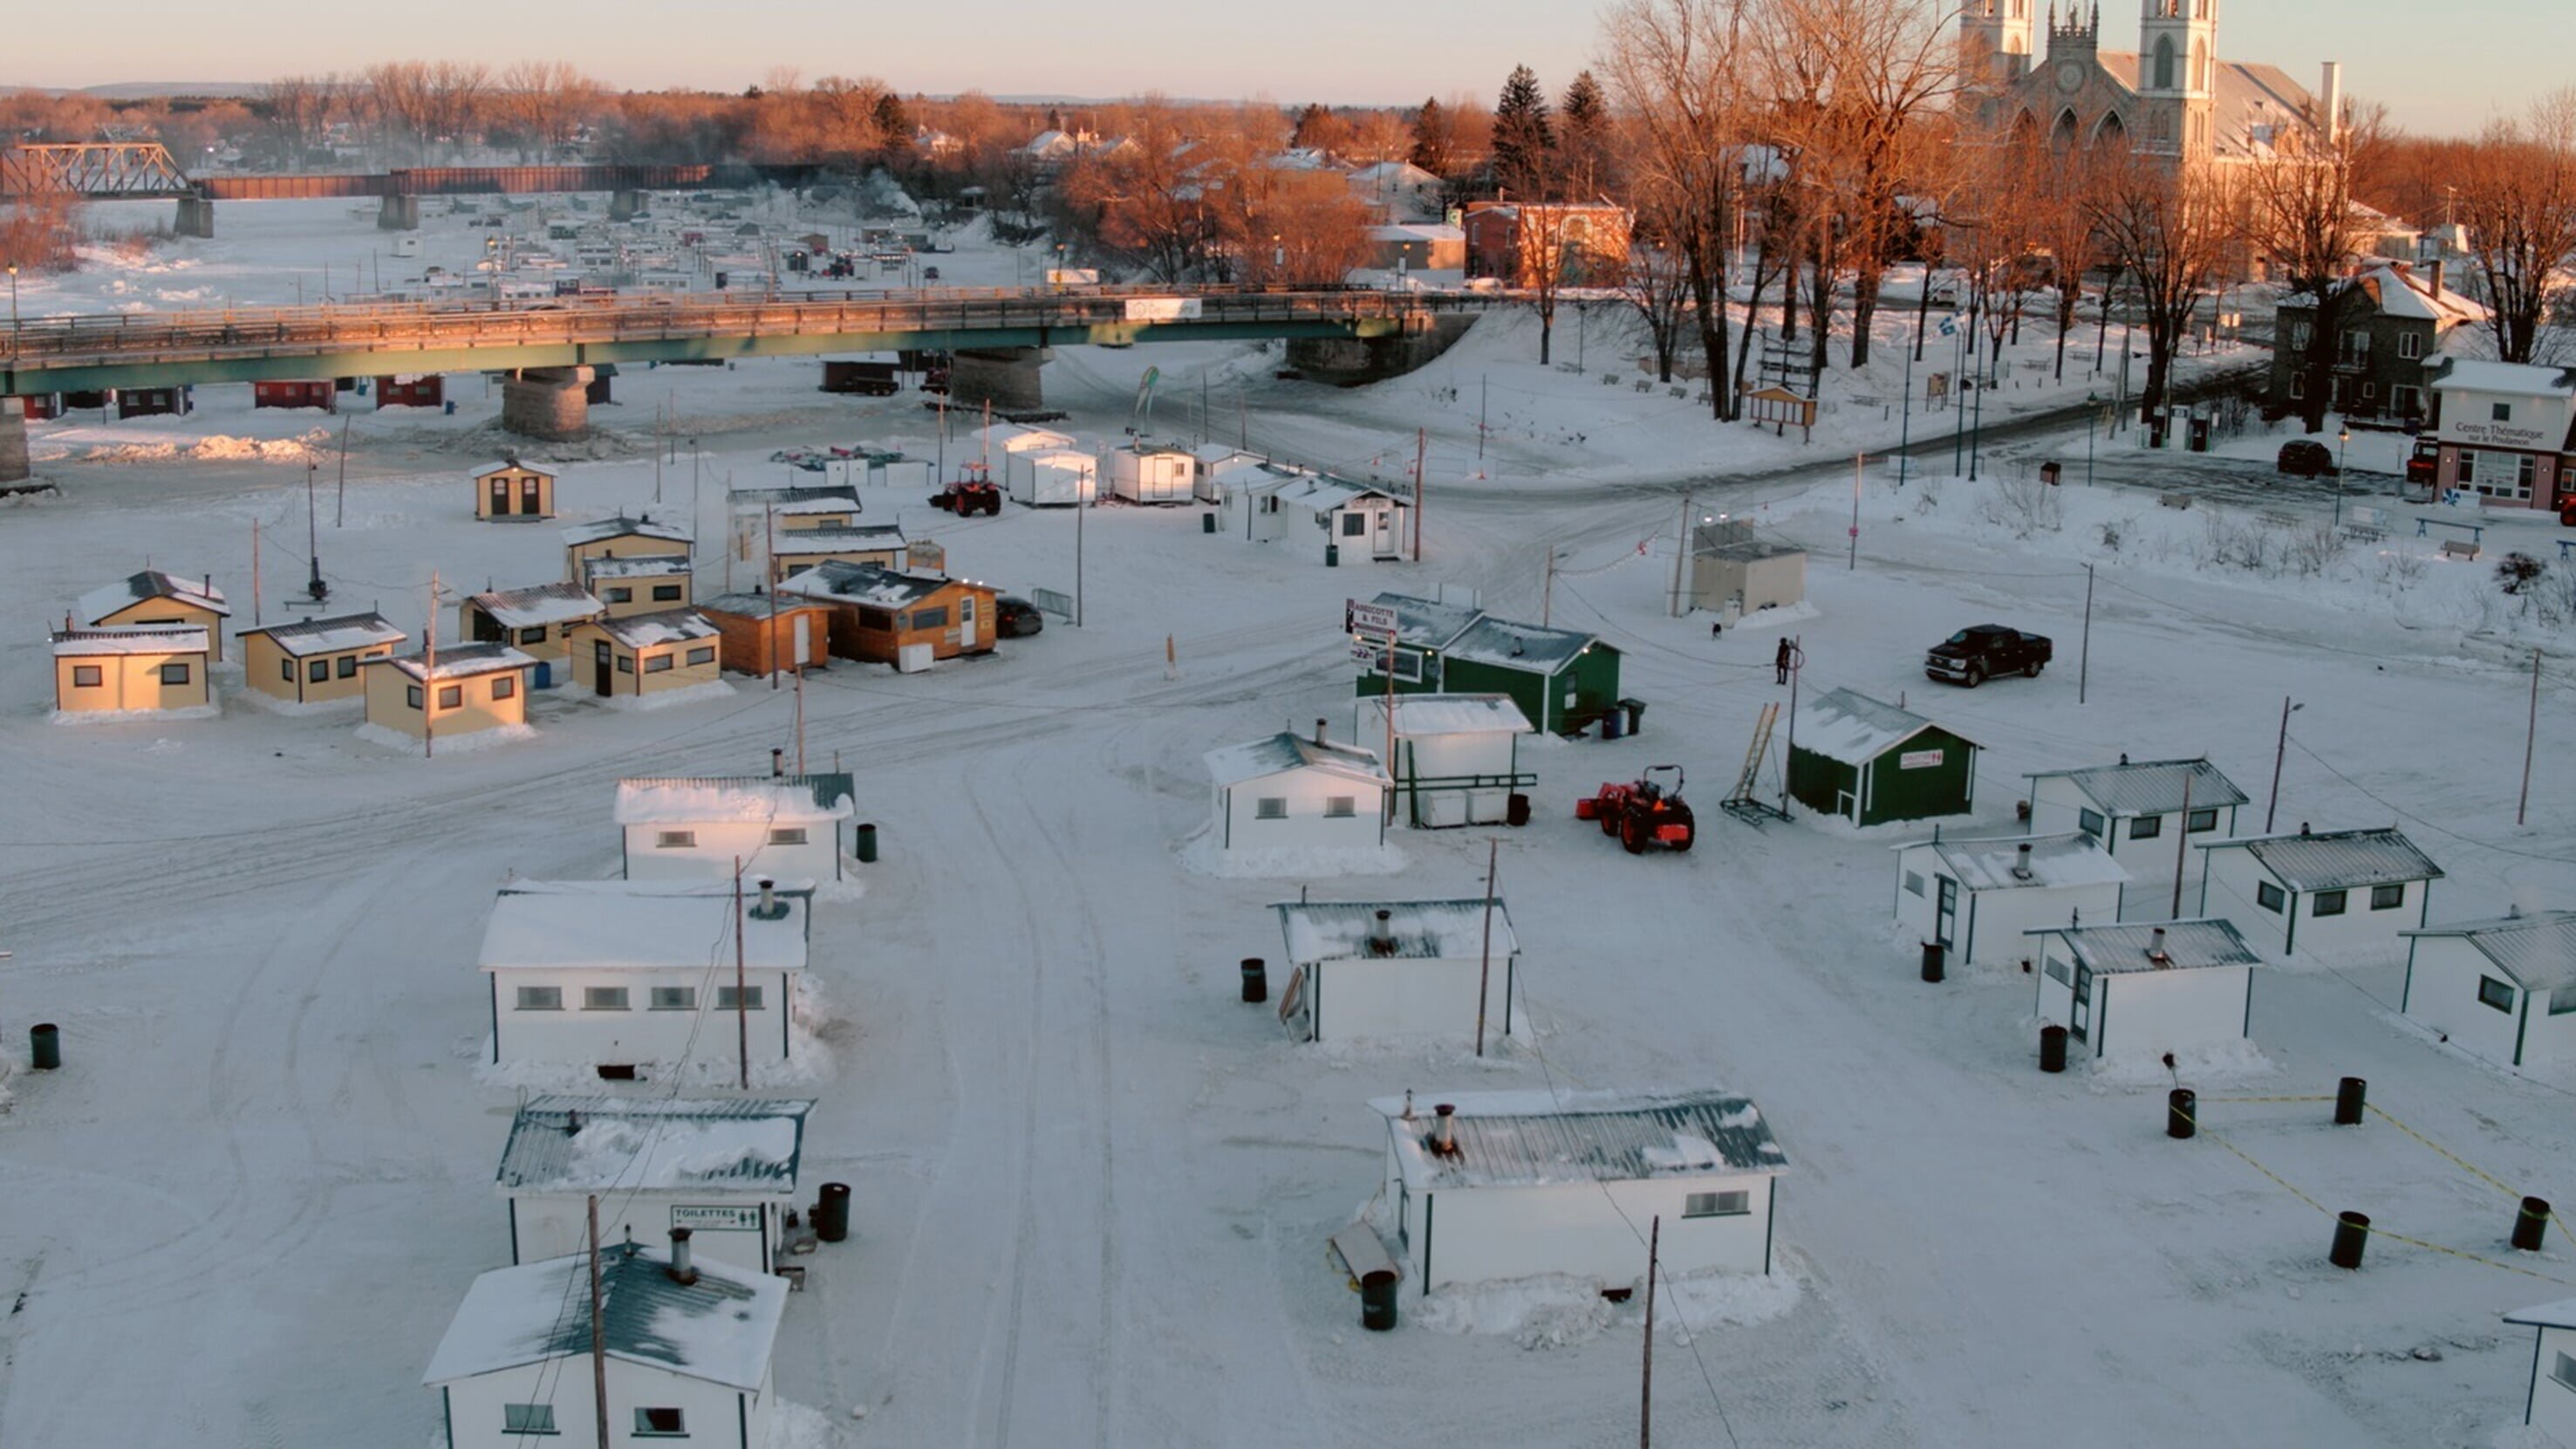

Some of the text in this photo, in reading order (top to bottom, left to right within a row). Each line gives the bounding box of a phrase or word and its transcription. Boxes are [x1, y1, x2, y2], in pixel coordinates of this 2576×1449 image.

[2456, 421, 2544, 440] Centre Thématique
[2491, 435, 2529, 446] Poulamon
[1371, 616, 1388, 625] FILS
